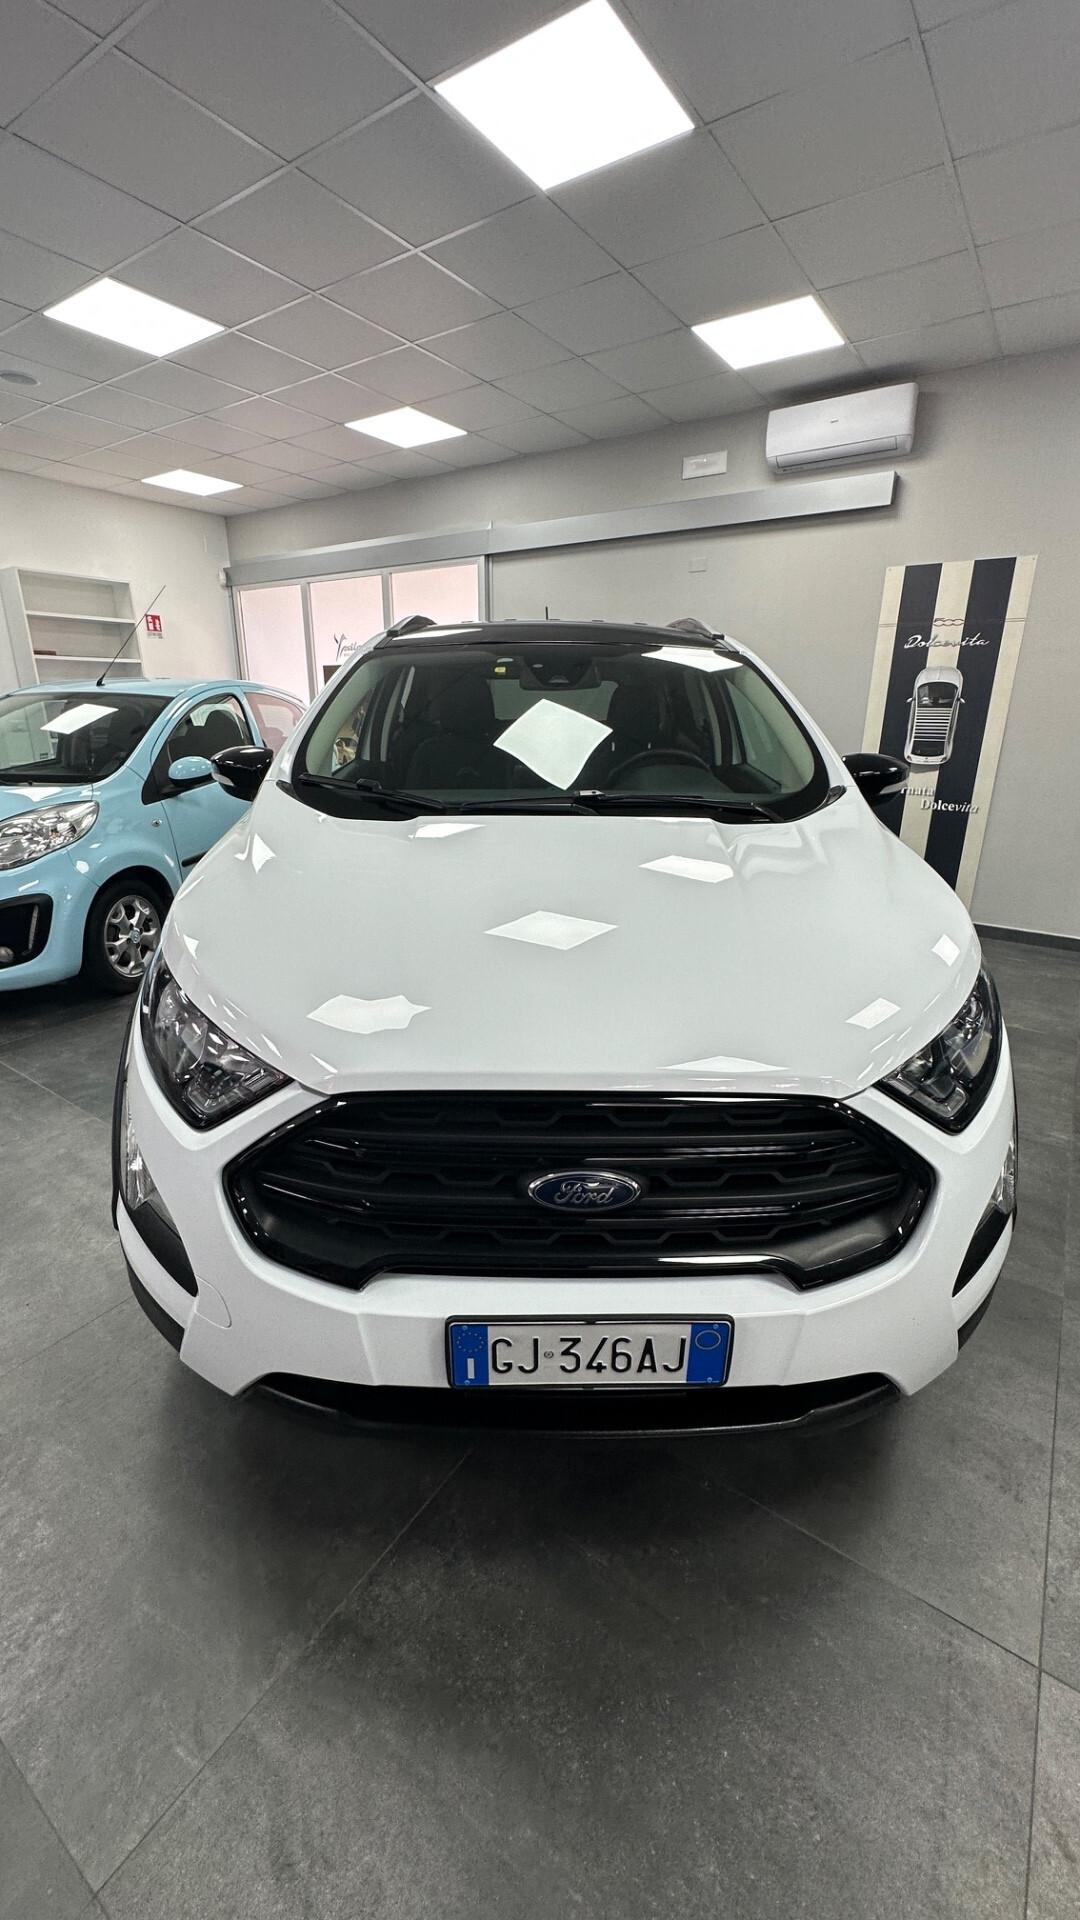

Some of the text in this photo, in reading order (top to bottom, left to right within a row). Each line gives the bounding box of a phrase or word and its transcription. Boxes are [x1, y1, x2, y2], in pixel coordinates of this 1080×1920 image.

[903, 632, 990, 649] Dolcevita
[920, 799, 979, 814] Dolcevita
[553, 1180, 620, 1204] Ford
